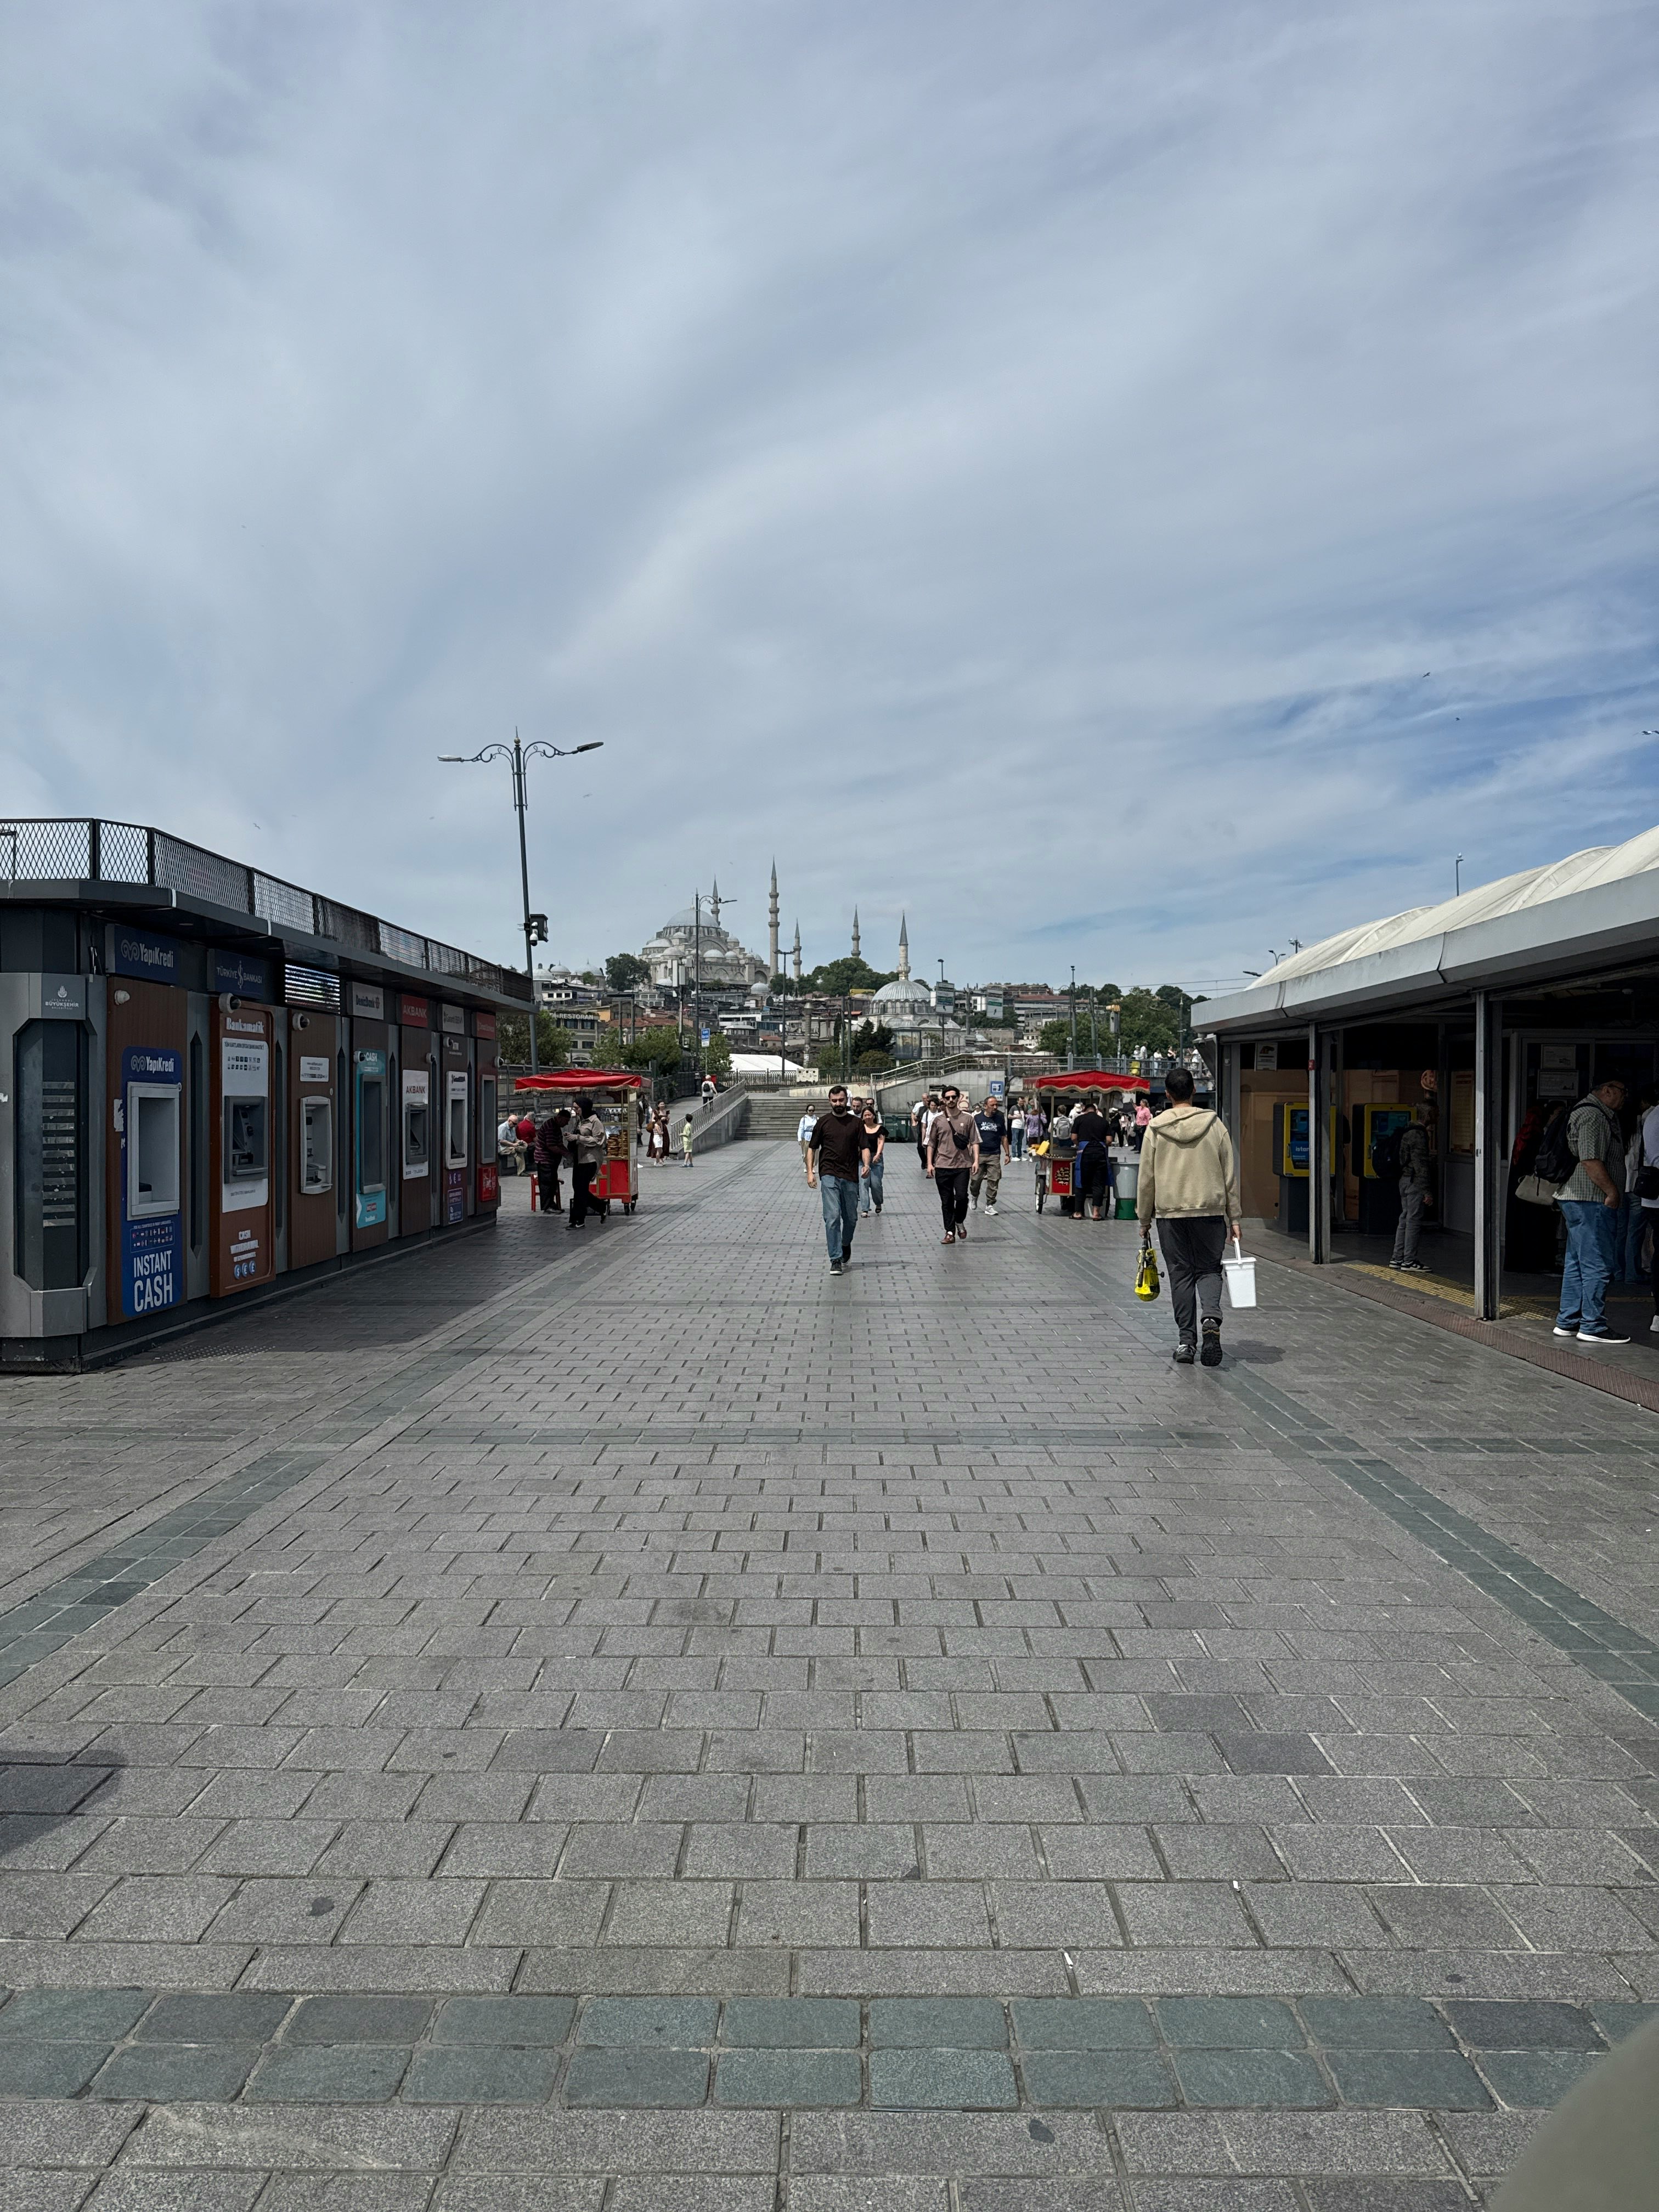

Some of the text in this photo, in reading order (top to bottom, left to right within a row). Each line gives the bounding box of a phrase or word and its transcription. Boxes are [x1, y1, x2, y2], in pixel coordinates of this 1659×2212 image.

[217, 966, 238, 980] TÜRKİYE
[243, 973, 263, 984] BANKASI
[403, 1005, 427, 1019] AKBANK
[226, 1017, 264, 1034] Bankamatik
[146, 1056, 174, 1074] YapıKredi
[366, 1052, 377, 1062] CASH
[406, 1086, 425, 1094] AKBANK
[133, 1250, 172, 1278] INSTANT
[134, 1273, 173, 1312] CASH
